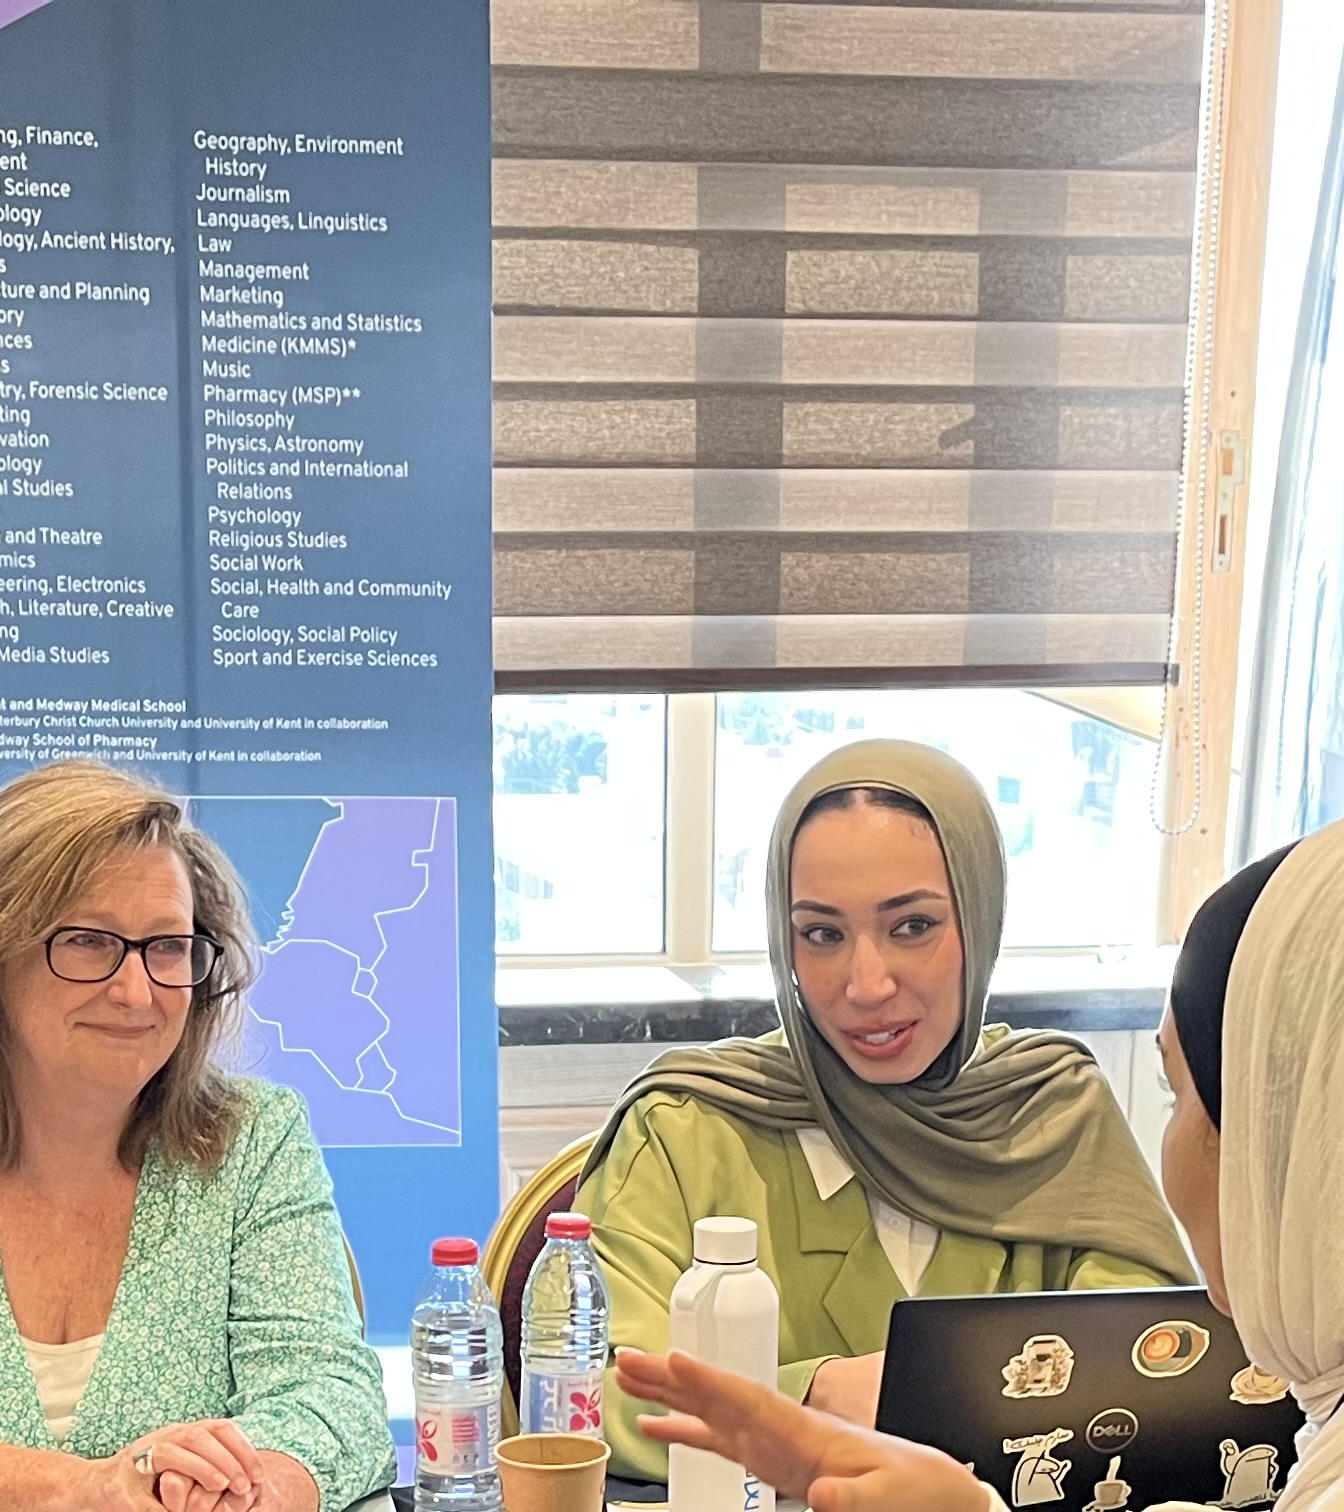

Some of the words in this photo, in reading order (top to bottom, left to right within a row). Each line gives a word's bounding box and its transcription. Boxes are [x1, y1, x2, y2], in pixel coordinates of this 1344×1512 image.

[26, 126, 98, 148] Finance,
[194, 130, 291, 156] Geography,
[295, 134, 403, 155] Environment
[206, 157, 267, 181] History
[4, 177, 71, 197] Science
[196, 182, 290, 203] Journalism
[197, 208, 294, 233] Languages,
[298, 211, 388, 235] Linguistics
[41, 230, 106, 250] Ancient
[111, 232, 175, 255] History,
[198, 234, 232, 252] Law
[199, 259, 309, 283] Management
[39, 282, 71, 300] and
[75, 282, 150, 306] Planning
[200, 285, 283, 309] Marketing
[201, 309, 307, 330] Mathematics
[311, 313, 342, 331] and
[347, 313, 422, 332] Statistics
[202, 335, 277, 354] Medicine
[203, 359, 251, 378] Music
[29, 380, 98, 400] Forensic
[103, 382, 168, 401] Science
[204, 384, 288, 407] Pharmacy
[205, 409, 295, 431] Philosophy
[206, 433, 272, 455] Physics,
[274, 435, 364, 456] Astronomy
[207, 457, 266, 476] Politics
[269, 459, 300, 476] and
[305, 459, 408, 478] International
[12, 478, 73, 497] Studies
[217, 482, 293, 500] Relations
[208, 506, 302, 528] Psychology
[5, 527, 36, 544] and
[39, 527, 103, 545] Theatre
[209, 530, 283, 551] Religious
[287, 531, 347, 548] Studies
[210, 554, 258, 571] Social
[261, 555, 304, 572] Work
[57, 575, 146, 594] Electronics
[211, 577, 263, 597] Social,
[267, 578, 319, 595] Health
[323, 579, 354, 596] and
[358, 579, 452, 601] Community
[18, 599, 103, 618] Literature,
[107, 600, 174, 618] Creative
[221, 601, 259, 618] Care
[212, 625, 294, 646] Sociology,
[298, 625, 345, 642] Social
[350, 626, 398, 646] Policy
[50, 646, 110, 664] Studies
[213, 648, 258, 668] Sport
[262, 649, 292, 665] and
[297, 649, 363, 666] Exercise
[367, 649, 438, 667] Sciences
[9, 698, 33, 711] and
[36, 698, 88, 714] Medway
[91, 699, 140, 712] Medical
[143, 699, 186, 713] School
[43, 715, 77, 727] Christ
[79, 715, 120, 728] Church
[121, 716, 178, 731] University
[180, 717, 202, 729] and
[203, 717, 260, 731] University
[262, 717, 274, 729] of
[276, 718, 302, 729] Kent
[304, 718, 315, 728] in
[317, 718, 388, 729] collaboration
[32, 733, 75, 746] School
[77, 733, 90, 746] of
[93, 734, 158, 749] Pharmacy
[37, 748, 49, 759] of
[113, 749, 134, 760] and
[136, 750, 193, 764] University
[195, 750, 207, 761] of
[209, 750, 235, 761] Kent
[237, 750, 248, 761] in
[250, 750, 321, 762] collaboration
[1093, 1424, 1132, 1438] DELL
